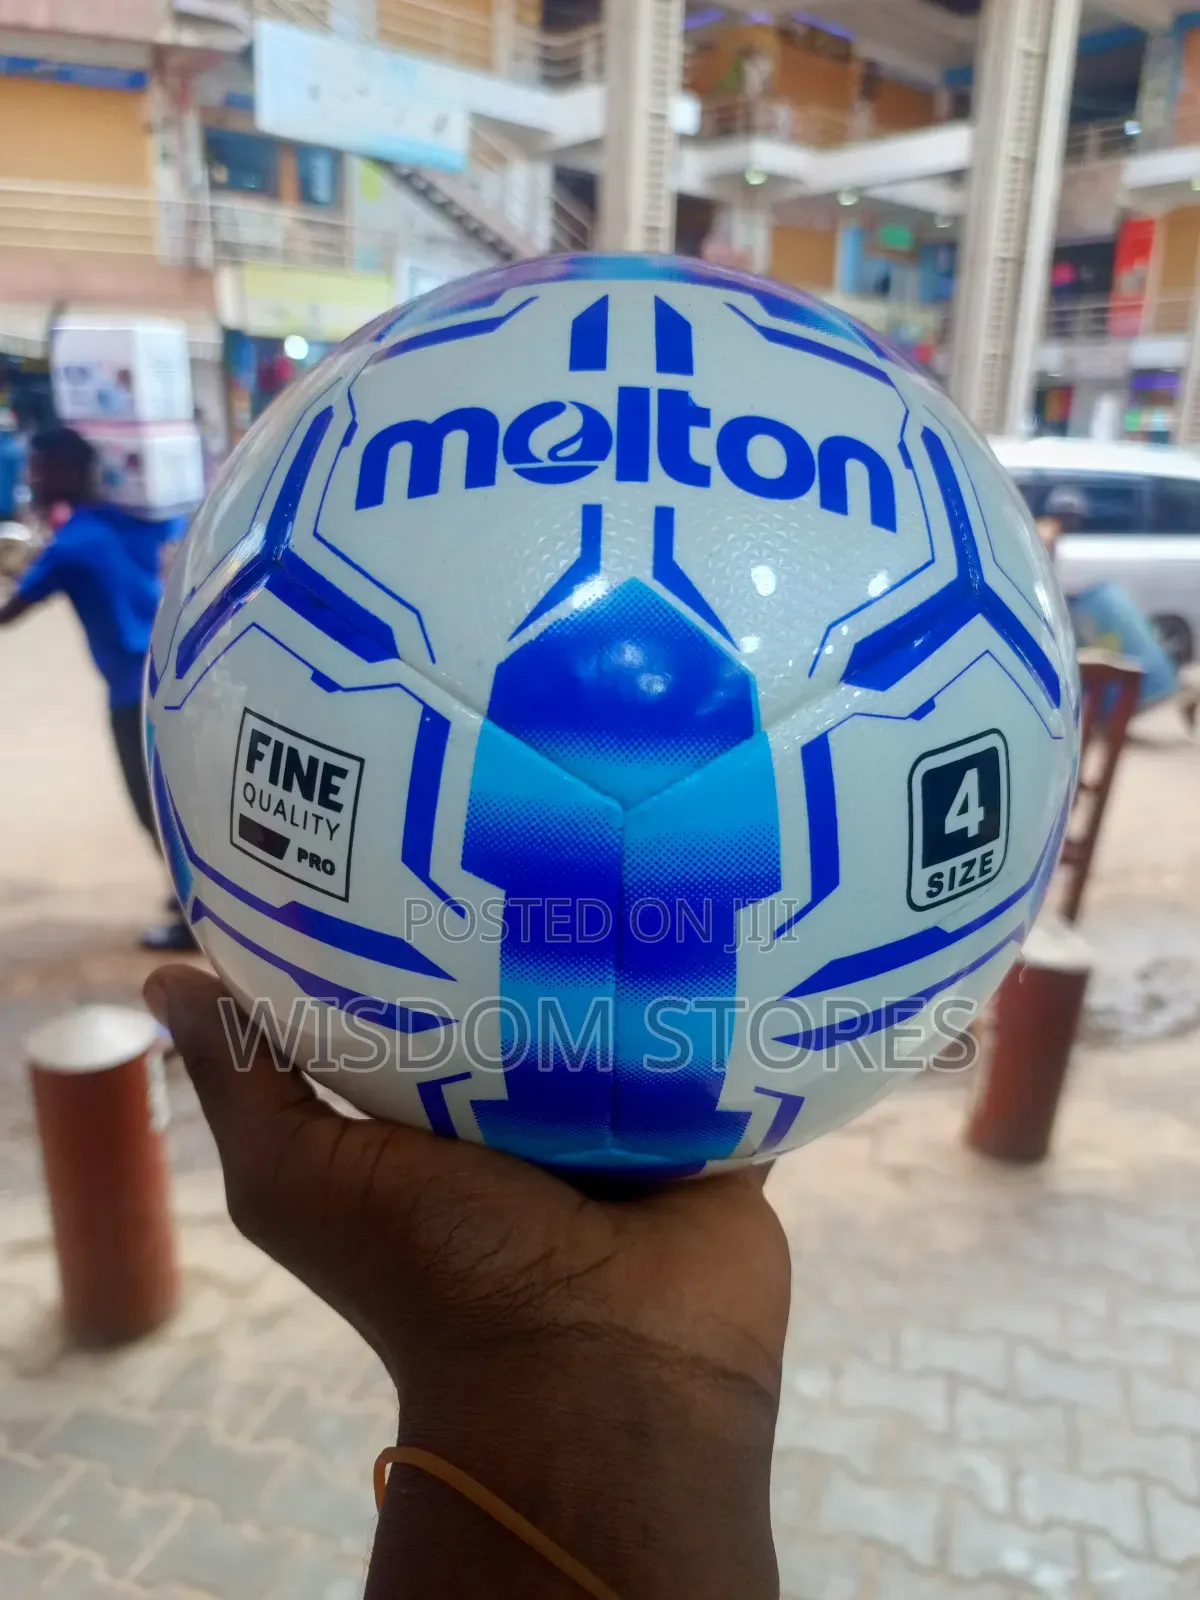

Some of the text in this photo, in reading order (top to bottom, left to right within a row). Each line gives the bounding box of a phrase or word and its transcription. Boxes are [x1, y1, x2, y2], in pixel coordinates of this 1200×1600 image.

[355, 386, 897, 533] molton
[246, 728, 348, 813] FINE
[944, 767, 985, 838] 4
[243, 781, 341, 841] QUALITY
[297, 846, 336, 876] PRO
[925, 849, 994, 899] SIZE
